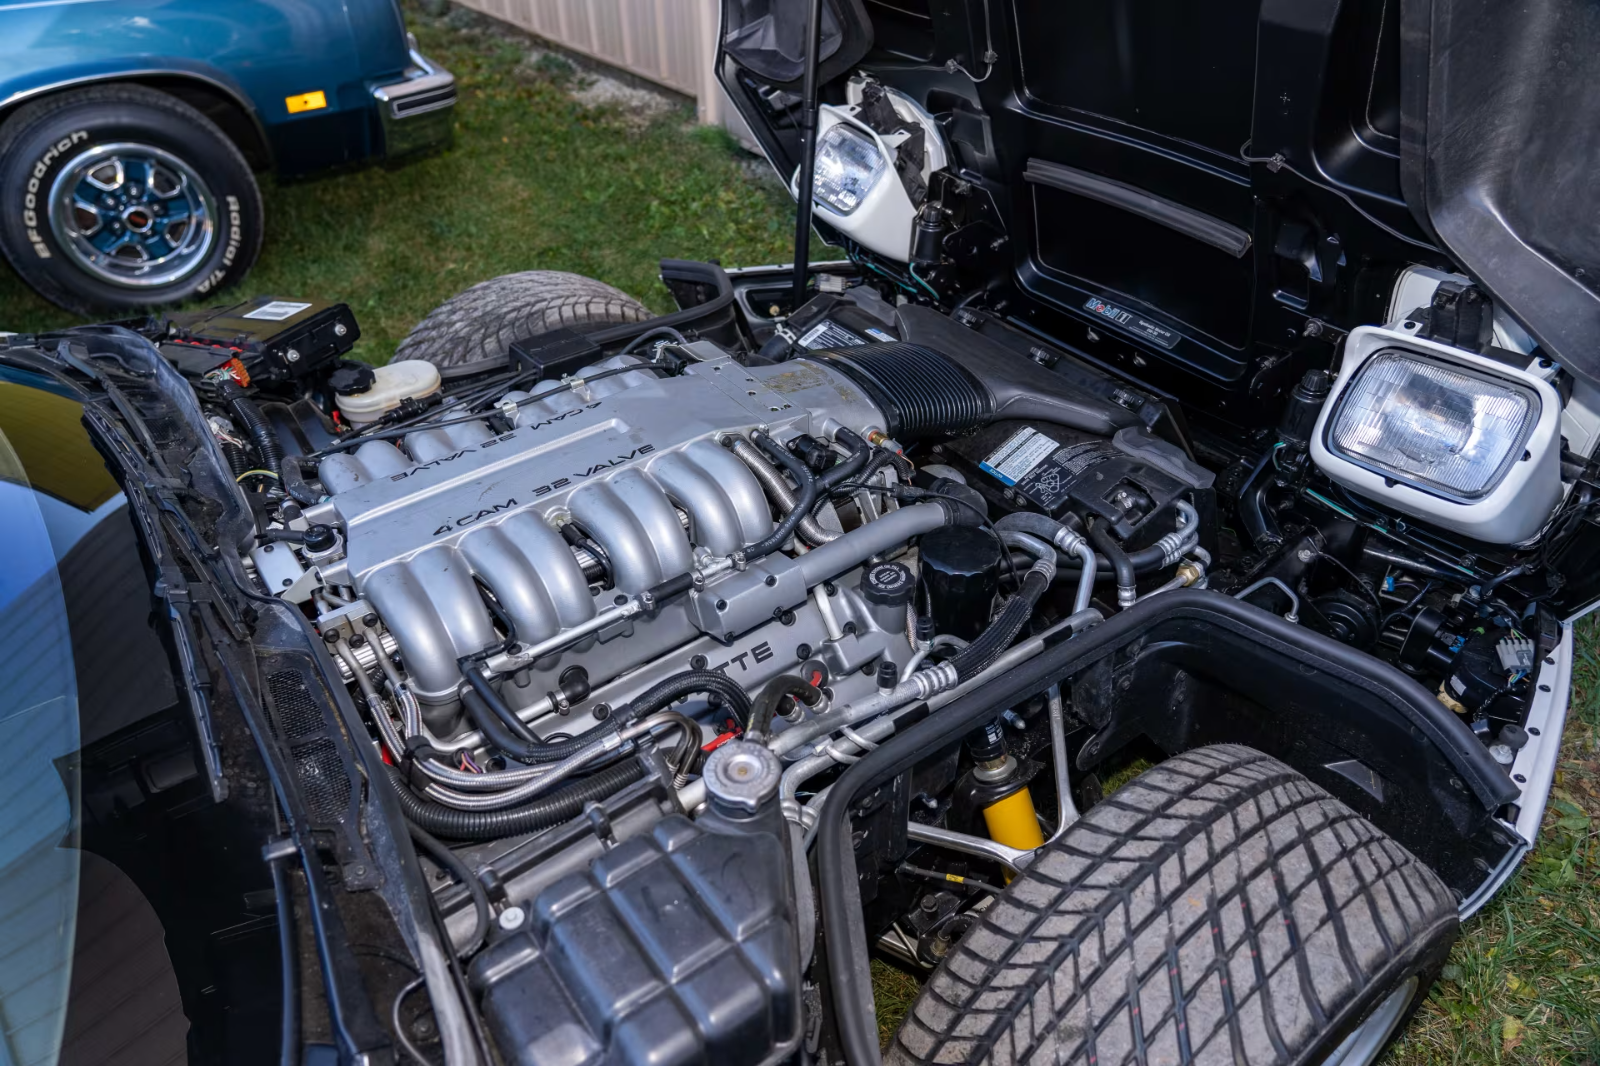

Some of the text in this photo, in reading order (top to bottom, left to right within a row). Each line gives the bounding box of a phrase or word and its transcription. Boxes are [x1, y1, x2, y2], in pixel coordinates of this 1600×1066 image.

[24, 130, 88, 259] BFGoodrich
[195, 195, 242, 294] Radial T/A
[1085, 297, 1121, 320] Mobil
[530, 408, 584, 431] CAM
[479, 432, 517, 449] 32
[390, 448, 477, 482] VALVE
[432, 444, 656, 536] 4 CAM 32 VALVE
